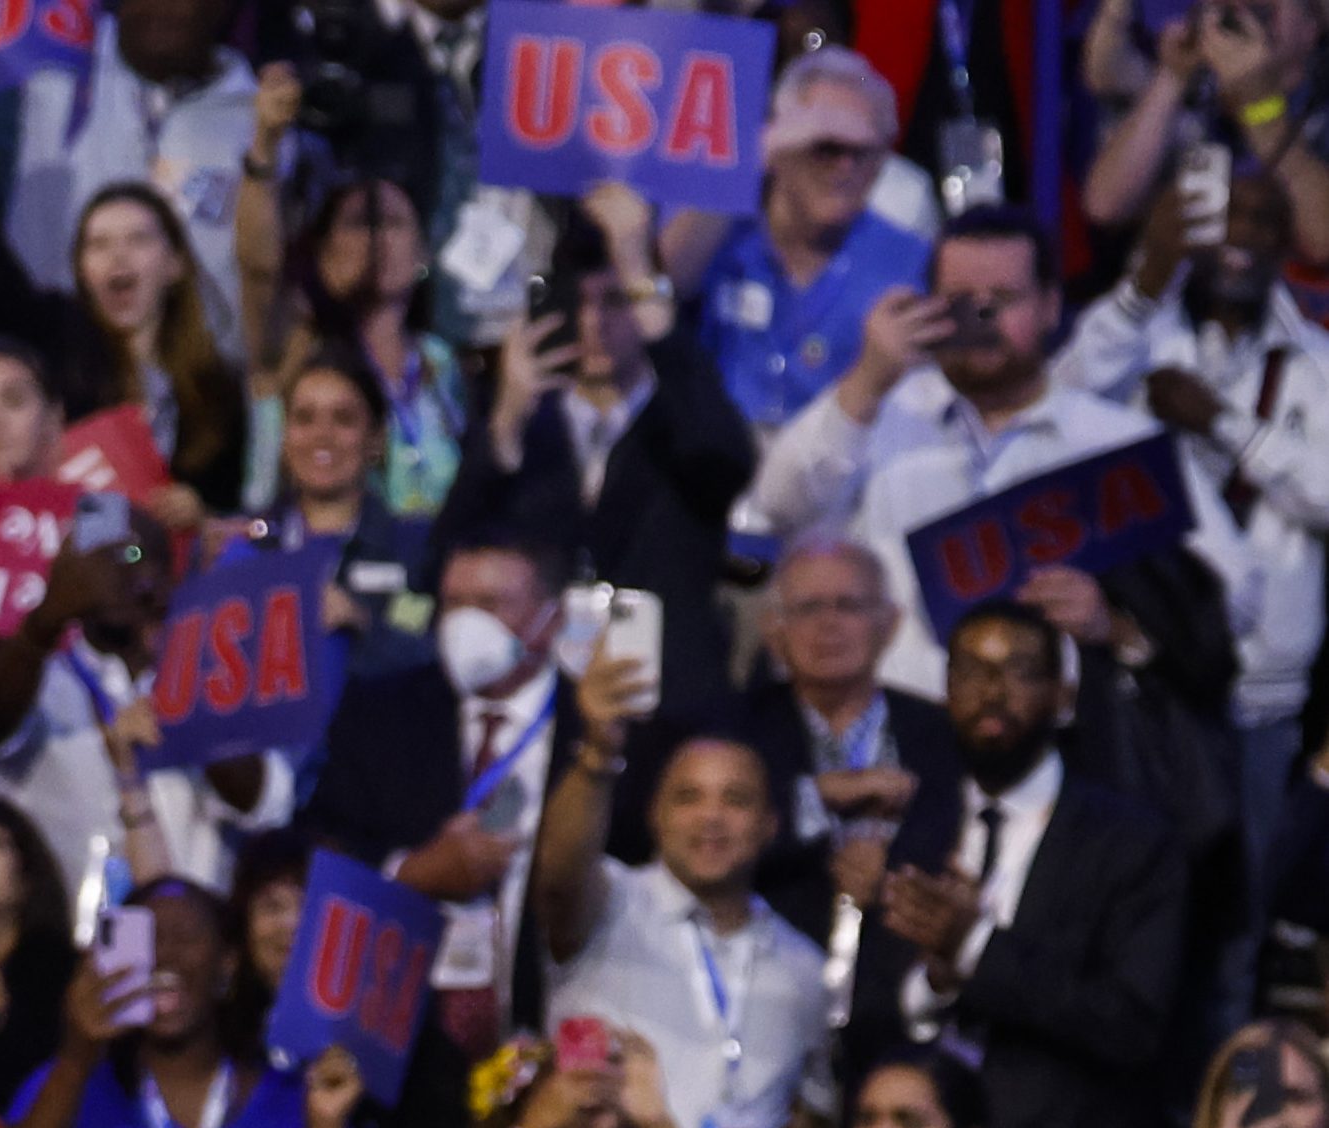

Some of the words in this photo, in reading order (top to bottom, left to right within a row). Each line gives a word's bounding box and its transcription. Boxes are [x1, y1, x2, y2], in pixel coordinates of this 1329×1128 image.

[506, 36, 736, 168] USA
[937, 464, 1164, 598] USA
[155, 588, 306, 724] USA
